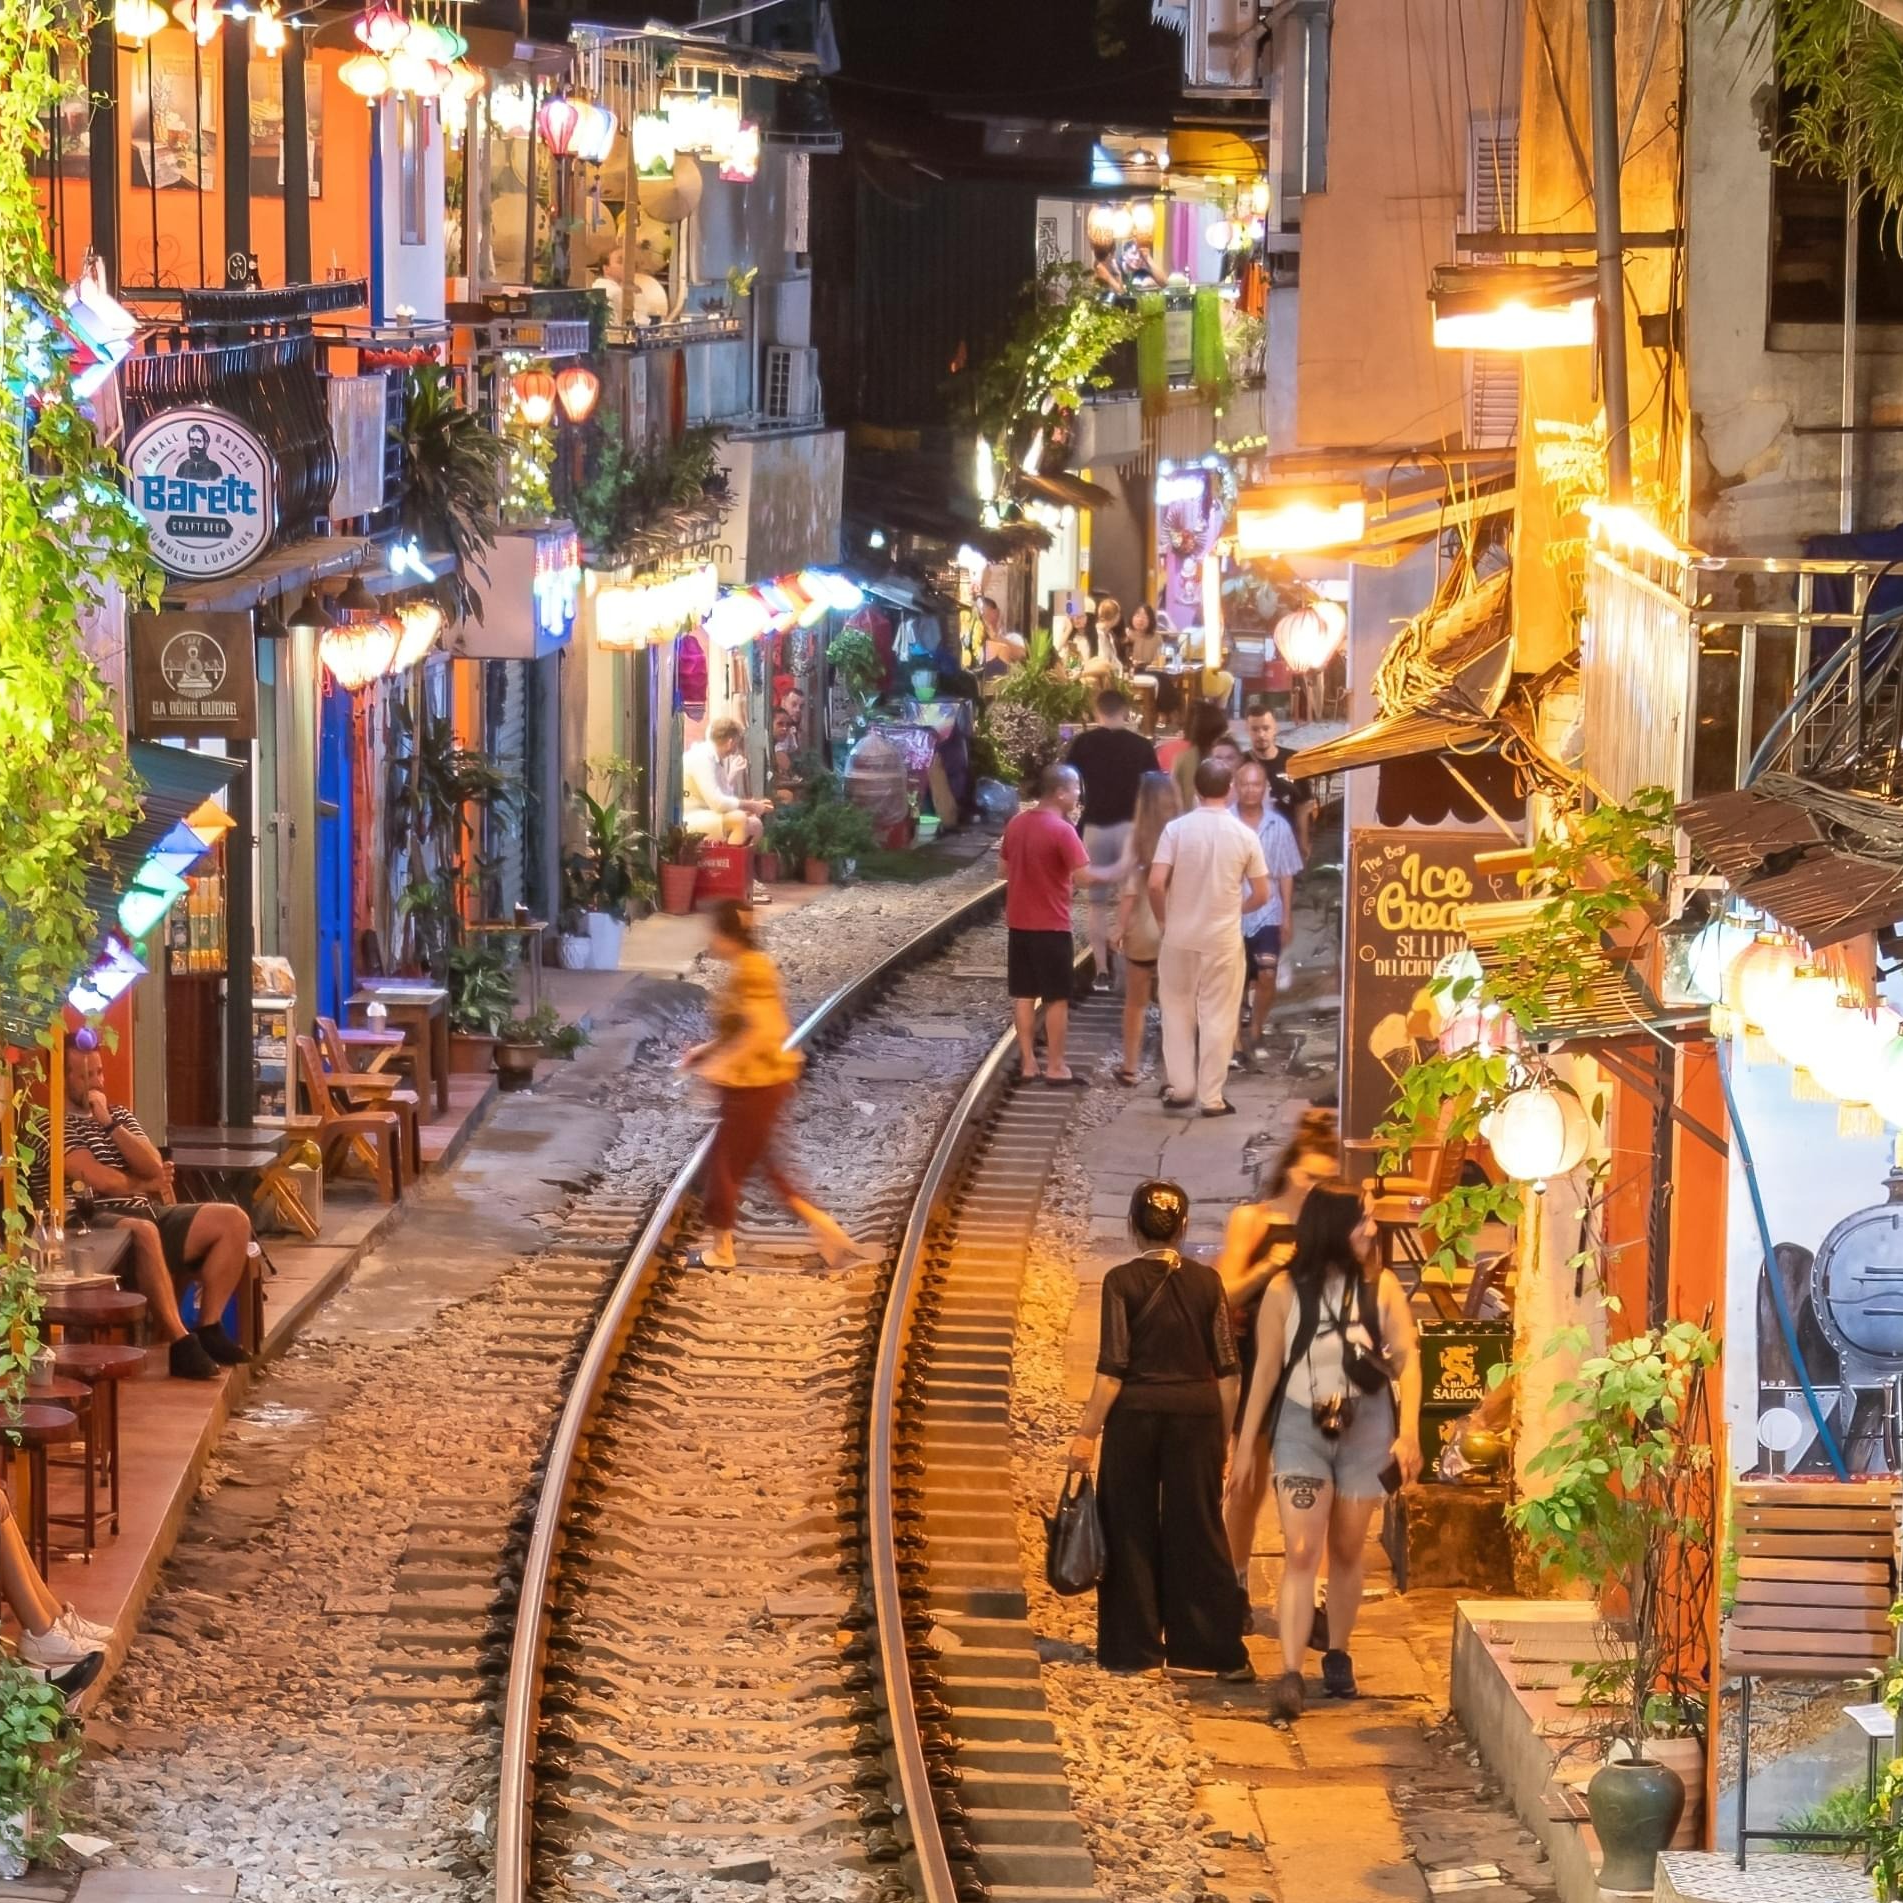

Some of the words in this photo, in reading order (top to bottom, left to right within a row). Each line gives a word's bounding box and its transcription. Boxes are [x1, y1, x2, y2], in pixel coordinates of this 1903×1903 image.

[143, 432, 179, 465] SMALL
[214, 433, 253, 469] BATCH
[136, 473, 258, 517] Barett
[171, 521, 201, 532] CRAFT
[203, 523, 227, 534] BEER
[204, 531, 255, 565] LUPULUS
[1360, 856, 1384, 874] The
[1401, 852, 1473, 899] Ice
[1377, 881, 1469, 932] Crea
[1375, 959, 1438, 977] DELICIOU
[1432, 1388, 1484, 1400] SAIGON
